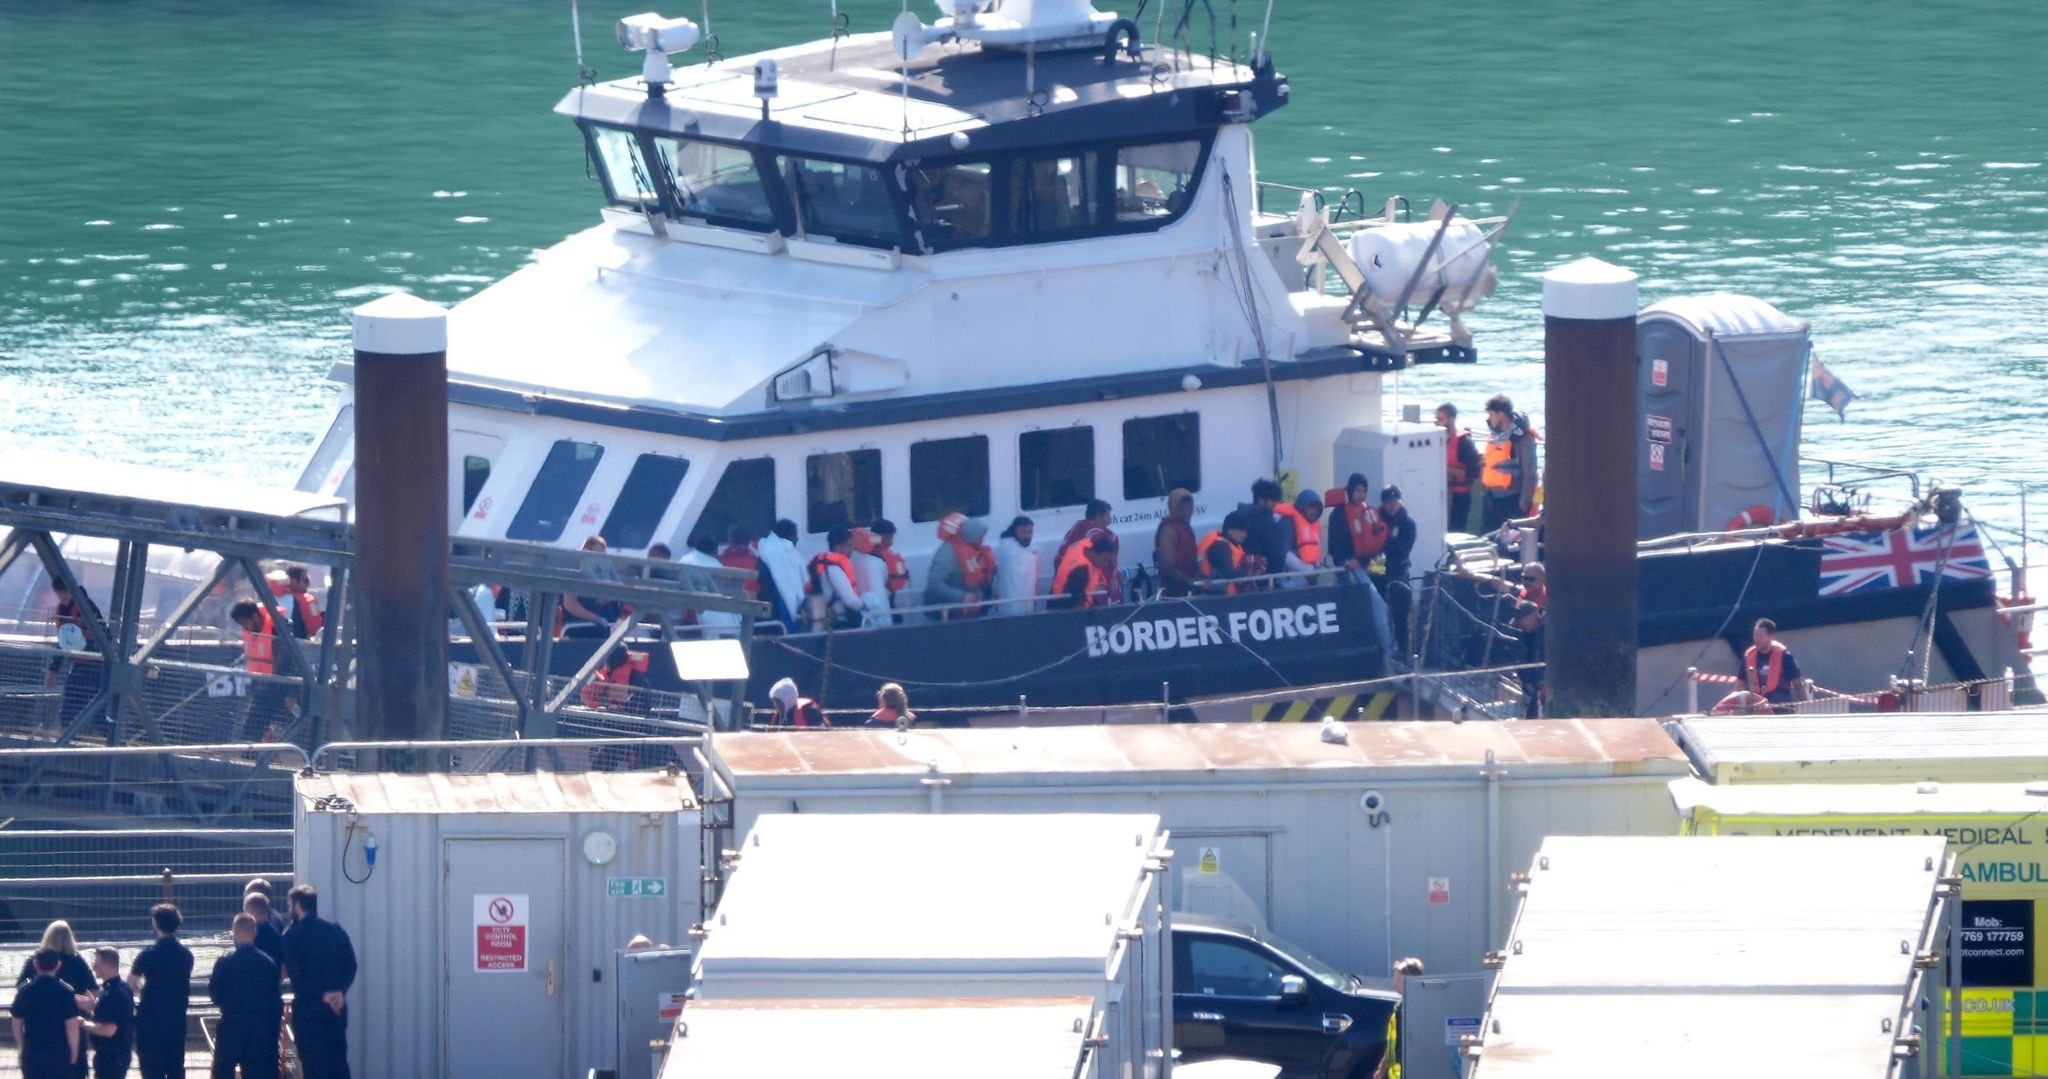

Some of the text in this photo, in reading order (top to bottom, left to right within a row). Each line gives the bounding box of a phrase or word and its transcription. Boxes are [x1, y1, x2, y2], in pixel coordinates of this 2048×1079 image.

[1085, 602, 1340, 657] BORDER FORCE
[1974, 917, 2002, 927] Mob:
[1986, 932, 2024, 941] 177759
